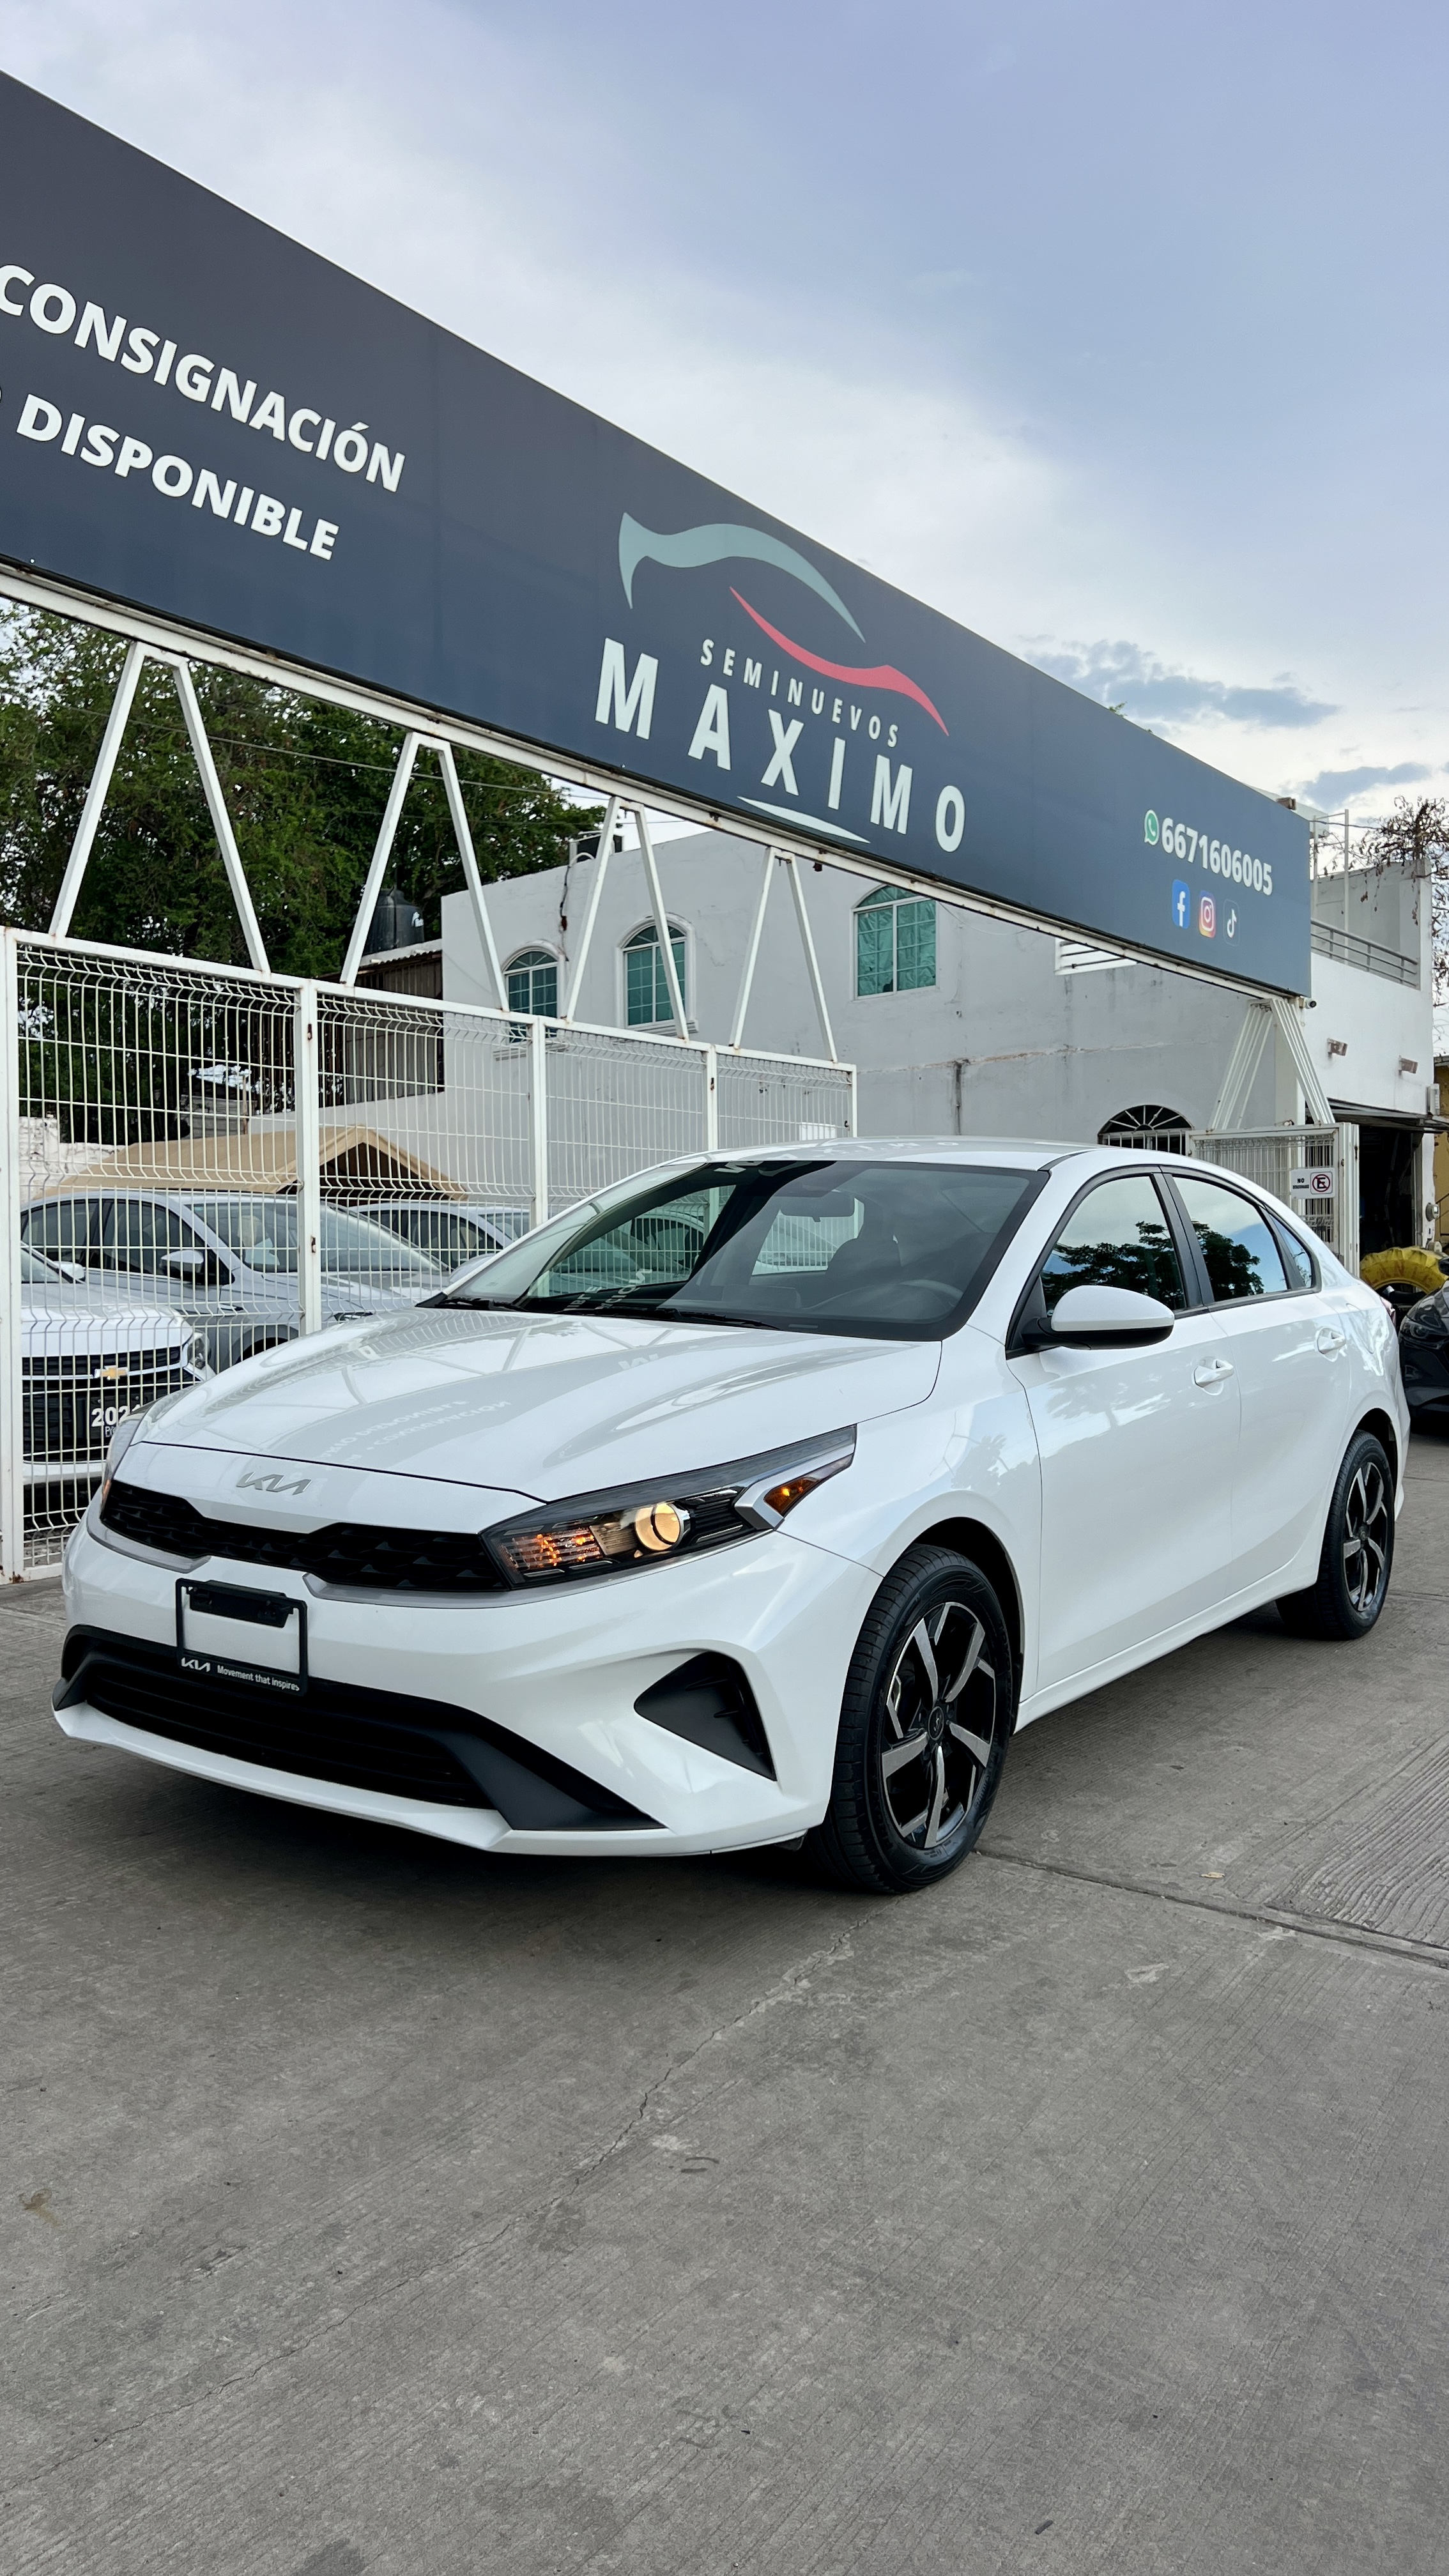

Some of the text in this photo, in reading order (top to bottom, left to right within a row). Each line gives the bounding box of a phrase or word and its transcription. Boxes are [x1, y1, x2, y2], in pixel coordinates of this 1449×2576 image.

[0, 264, 406, 493] CONSIGNACIÓN
[17, 394, 339, 560] DISPONIBLE
[595, 638, 965, 853] MAXIMO
[700, 638, 898, 747] SEMINUEVOS
[1161, 817, 1273, 896] 6671606005
[91, 1404, 141, 1427] 202
[217, 1665, 254, 1681] Movement
[255, 1674, 270, 1685] that
[272, 1678, 300, 1691] inspires
